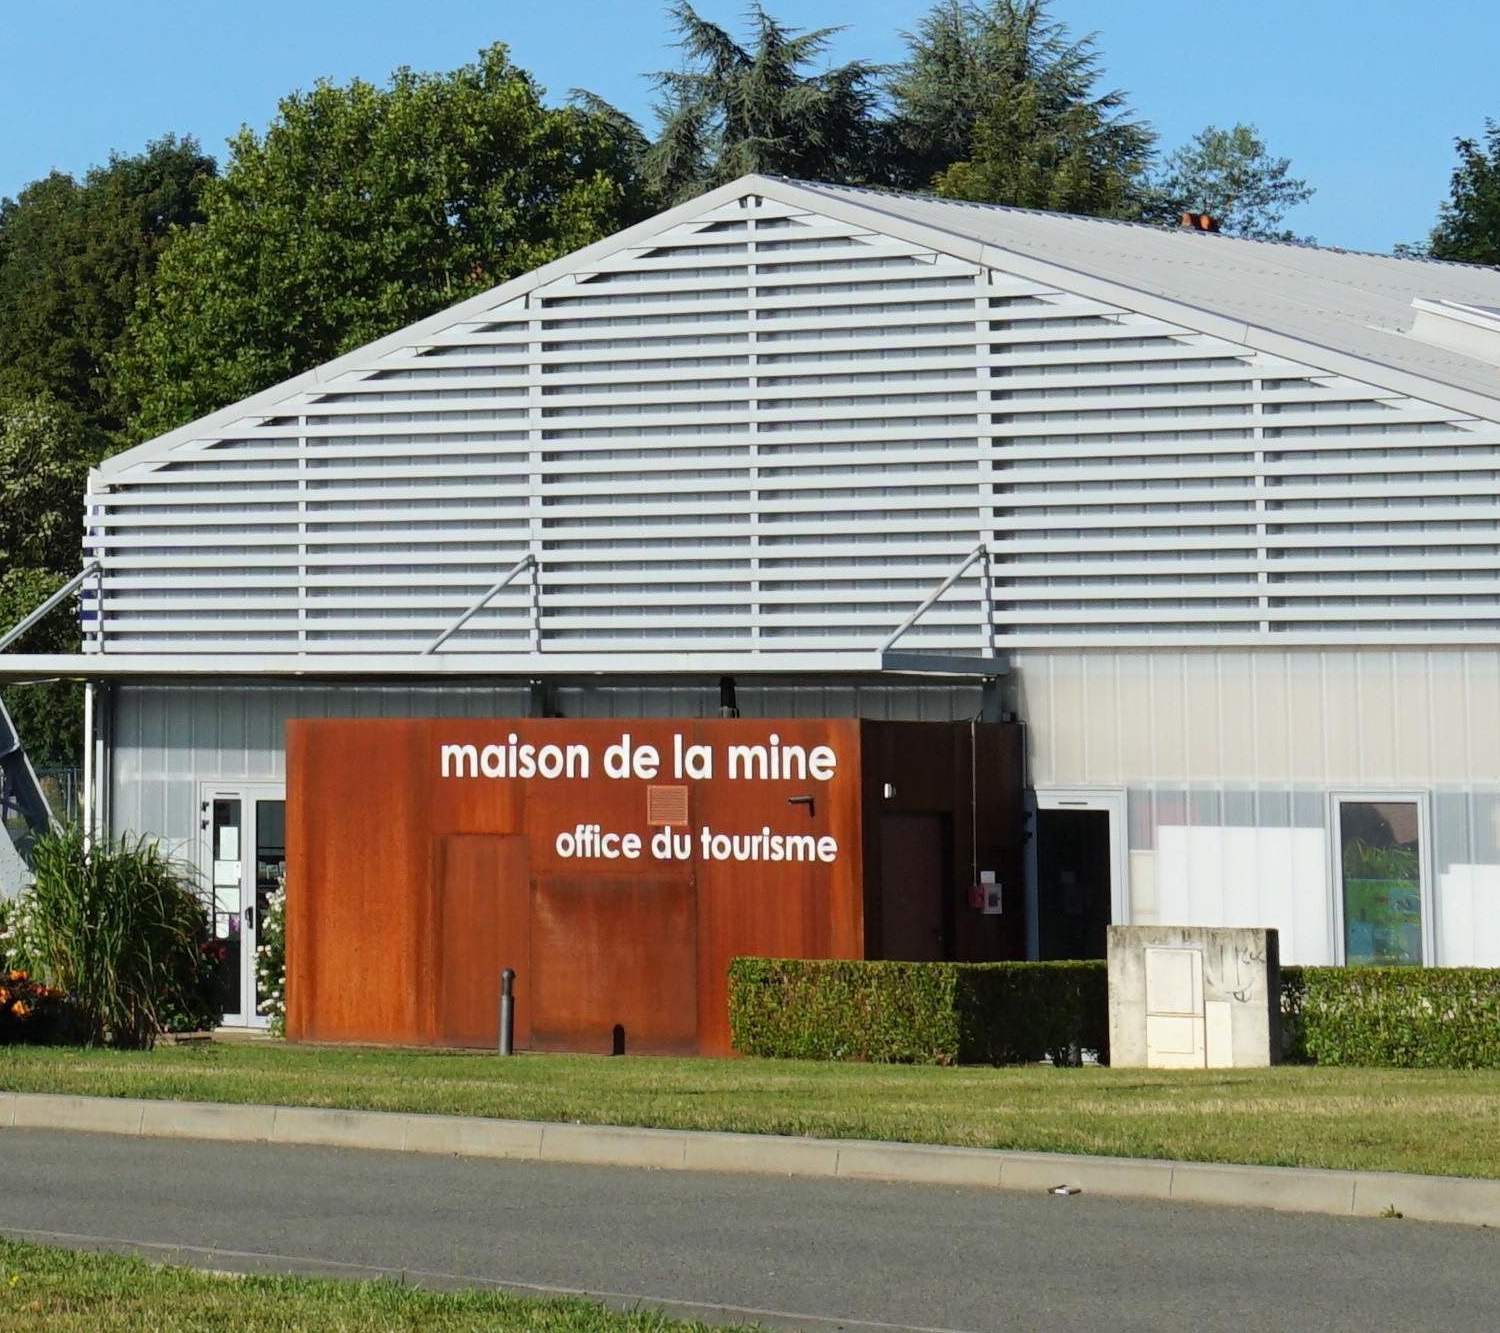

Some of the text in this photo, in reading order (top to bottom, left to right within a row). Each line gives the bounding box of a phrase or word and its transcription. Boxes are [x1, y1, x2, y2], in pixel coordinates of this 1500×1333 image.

[441, 732, 837, 781] maison de la mine
[555, 823, 838, 863] office du tourisme
